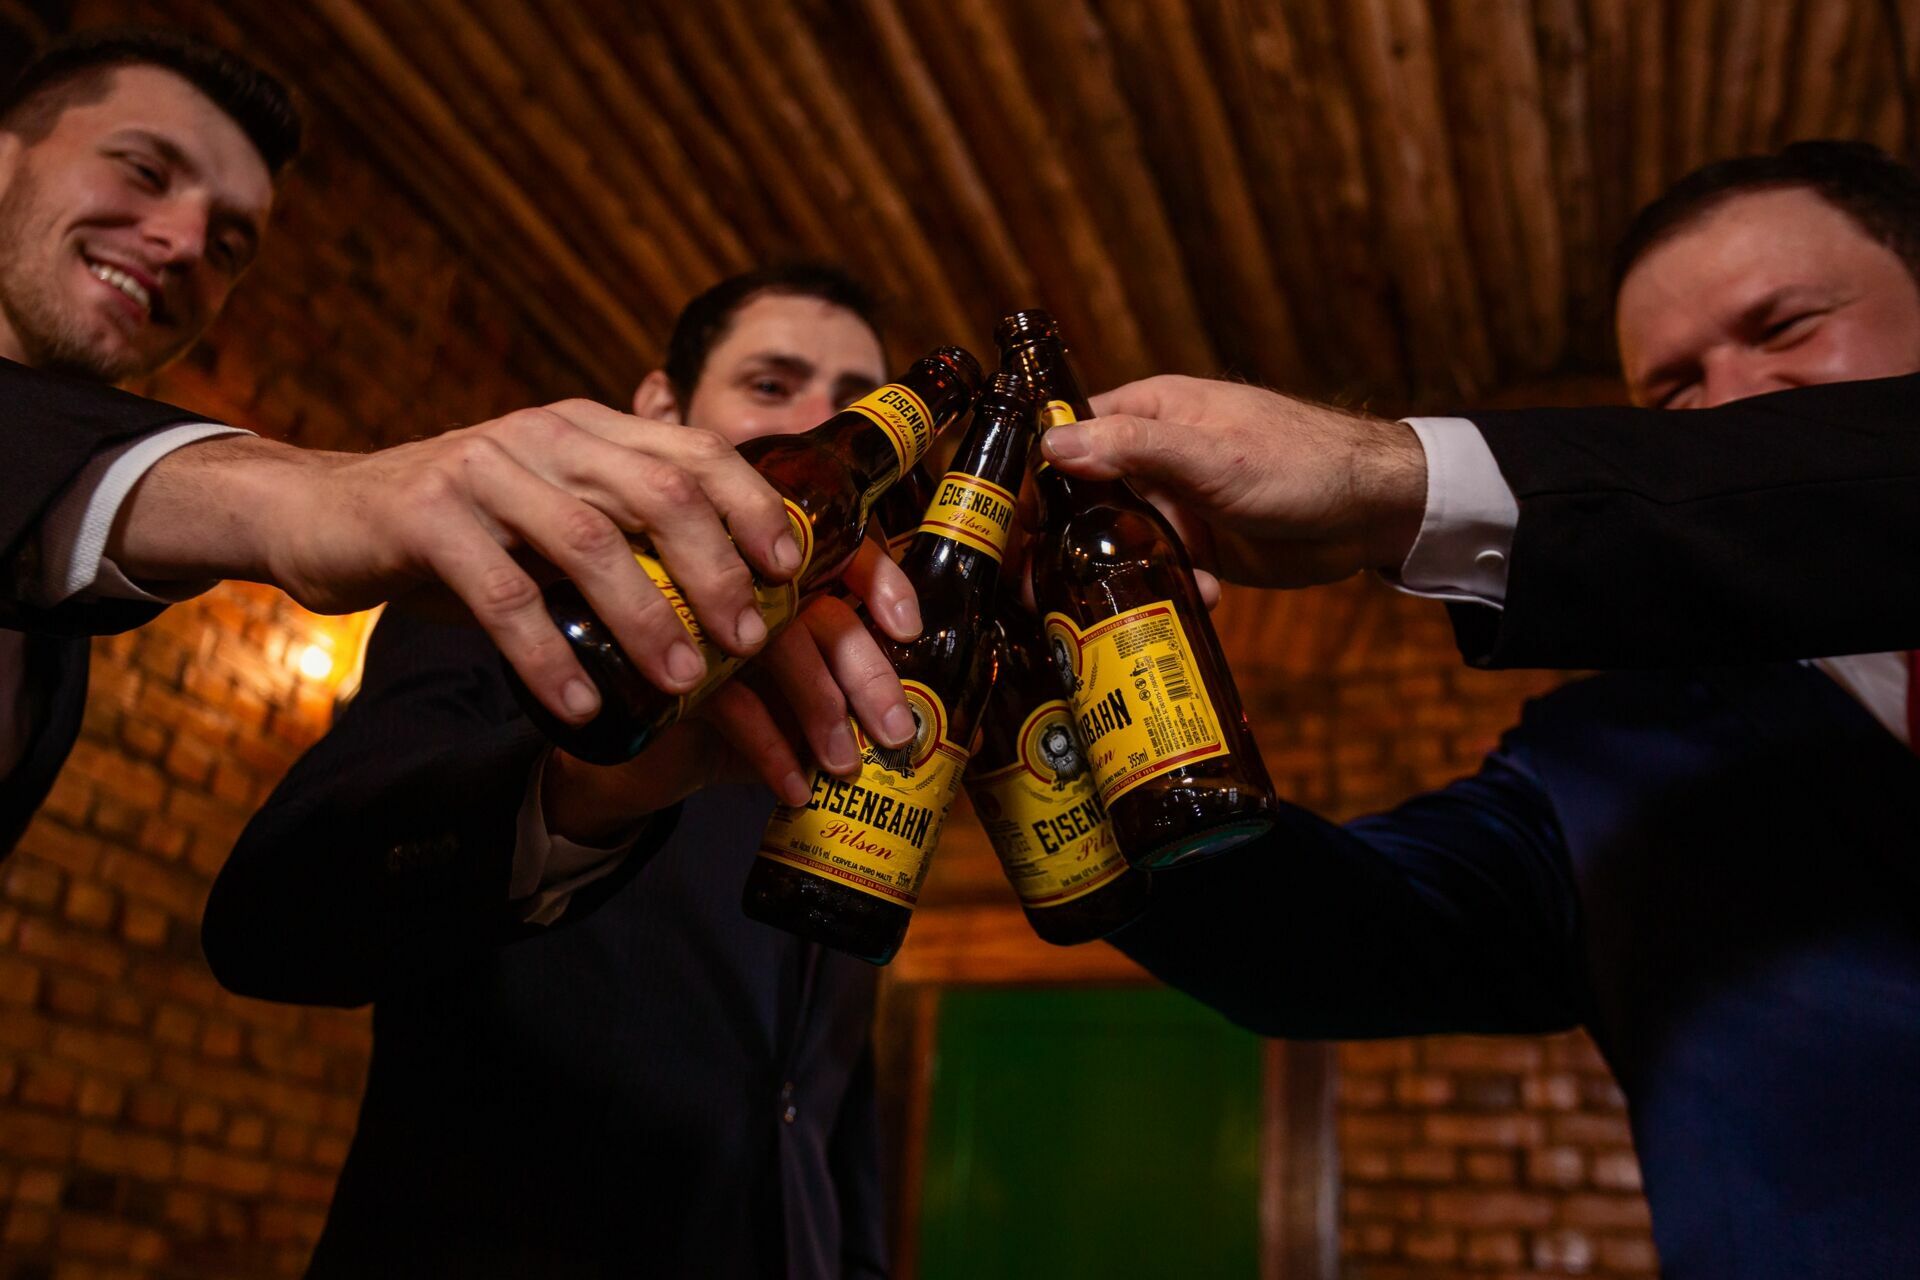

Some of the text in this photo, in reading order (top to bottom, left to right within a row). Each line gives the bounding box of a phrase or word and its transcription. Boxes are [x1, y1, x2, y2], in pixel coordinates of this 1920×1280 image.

[884, 411, 911, 449] Pilsen
[939, 484, 1013, 534] EISENBAHN
[948, 511, 992, 536] Pilsen
[1128, 747, 1149, 768] 355ml
[806, 770, 934, 849] EISENBAHN
[820, 819, 896, 860] Pilsen
[832, 856, 858, 870] CERVEJA
[859, 865, 876, 875] PURO
[876, 871, 892, 882] MALTE
